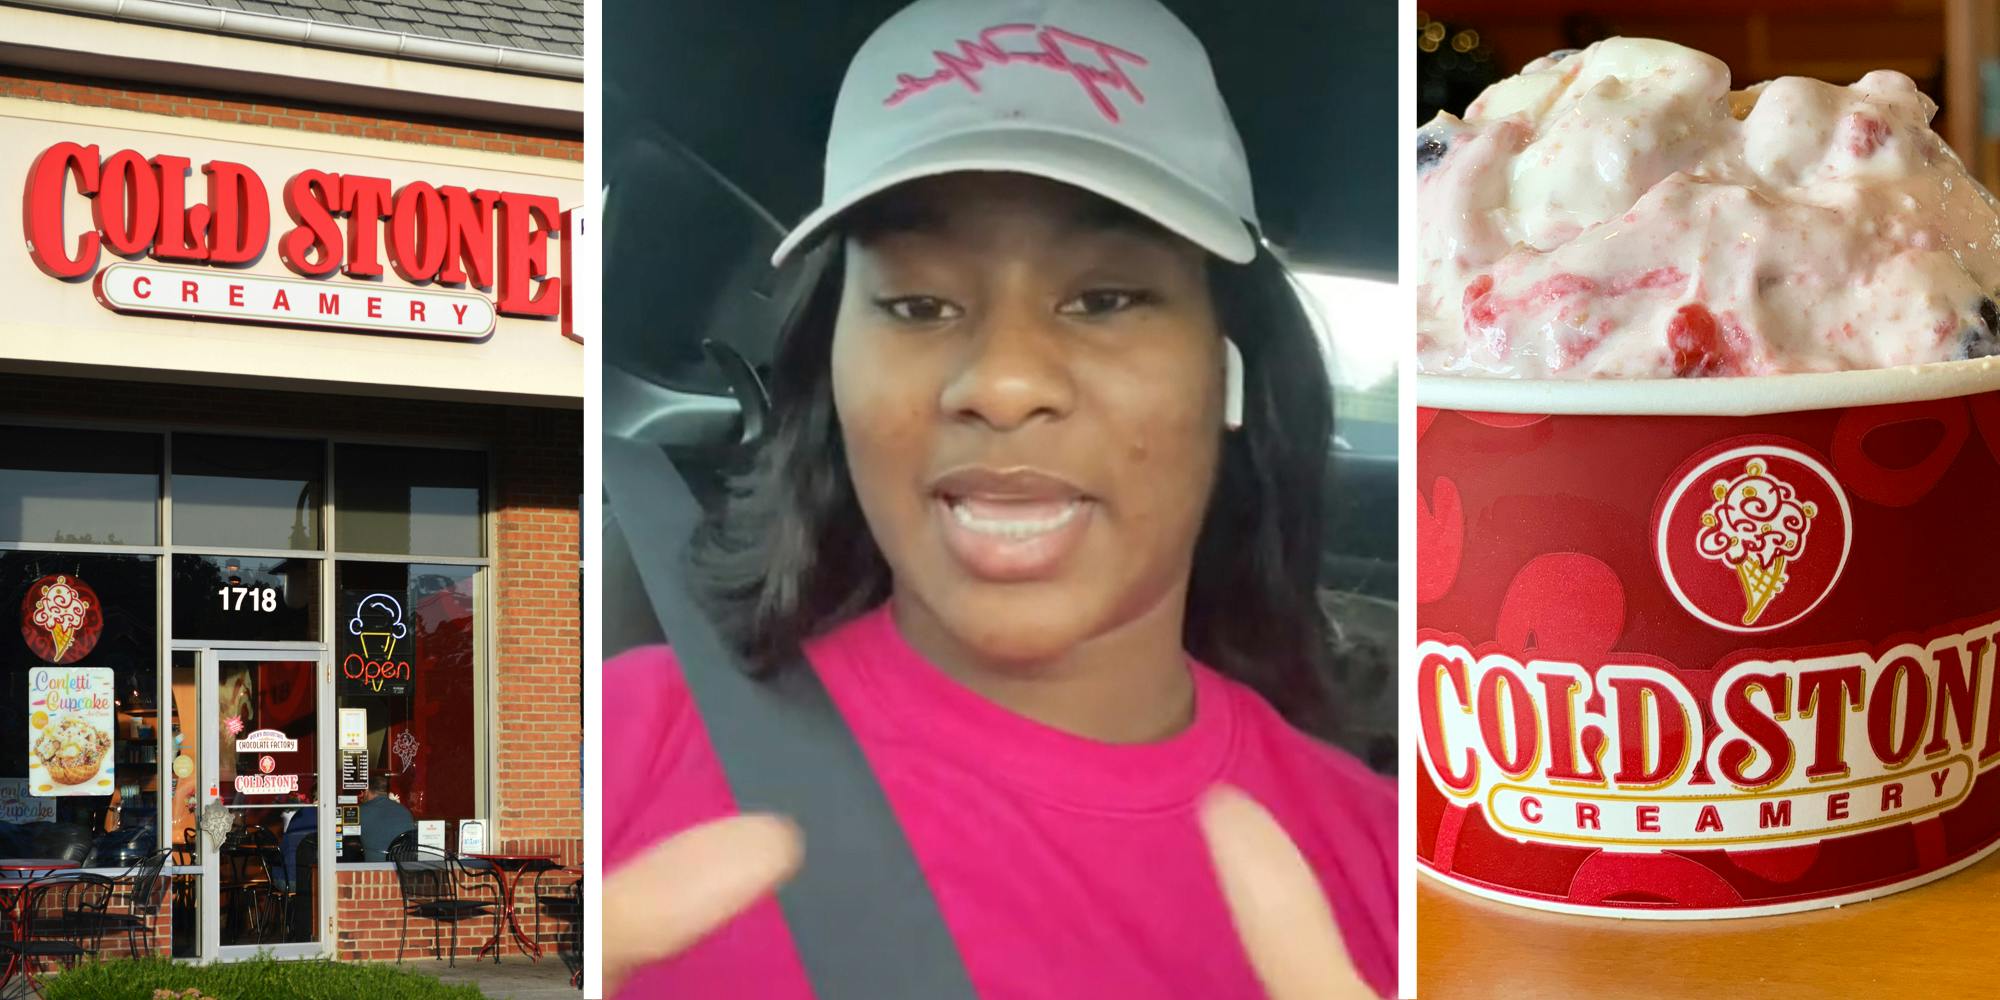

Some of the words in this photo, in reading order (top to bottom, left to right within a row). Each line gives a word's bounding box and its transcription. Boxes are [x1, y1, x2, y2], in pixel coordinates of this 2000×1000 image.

[23, 141, 270, 279] COLD
[279, 169, 562, 317] STONE
[132, 276, 469, 326] CREAMERY
[218, 586, 277, 613] 1718
[35, 670, 92, 696] Confetti
[344, 653, 411, 685] Open
[46, 691, 110, 712] Cupcake
[1417, 652, 1694, 796] COLD
[239, 741, 269, 750] CHOCOLATE
[270, 741, 295, 750] FACTORY
[236, 775, 264, 792] COLD
[264, 775, 298, 790] STONE
[1520, 767, 1951, 833] CREAMERY
